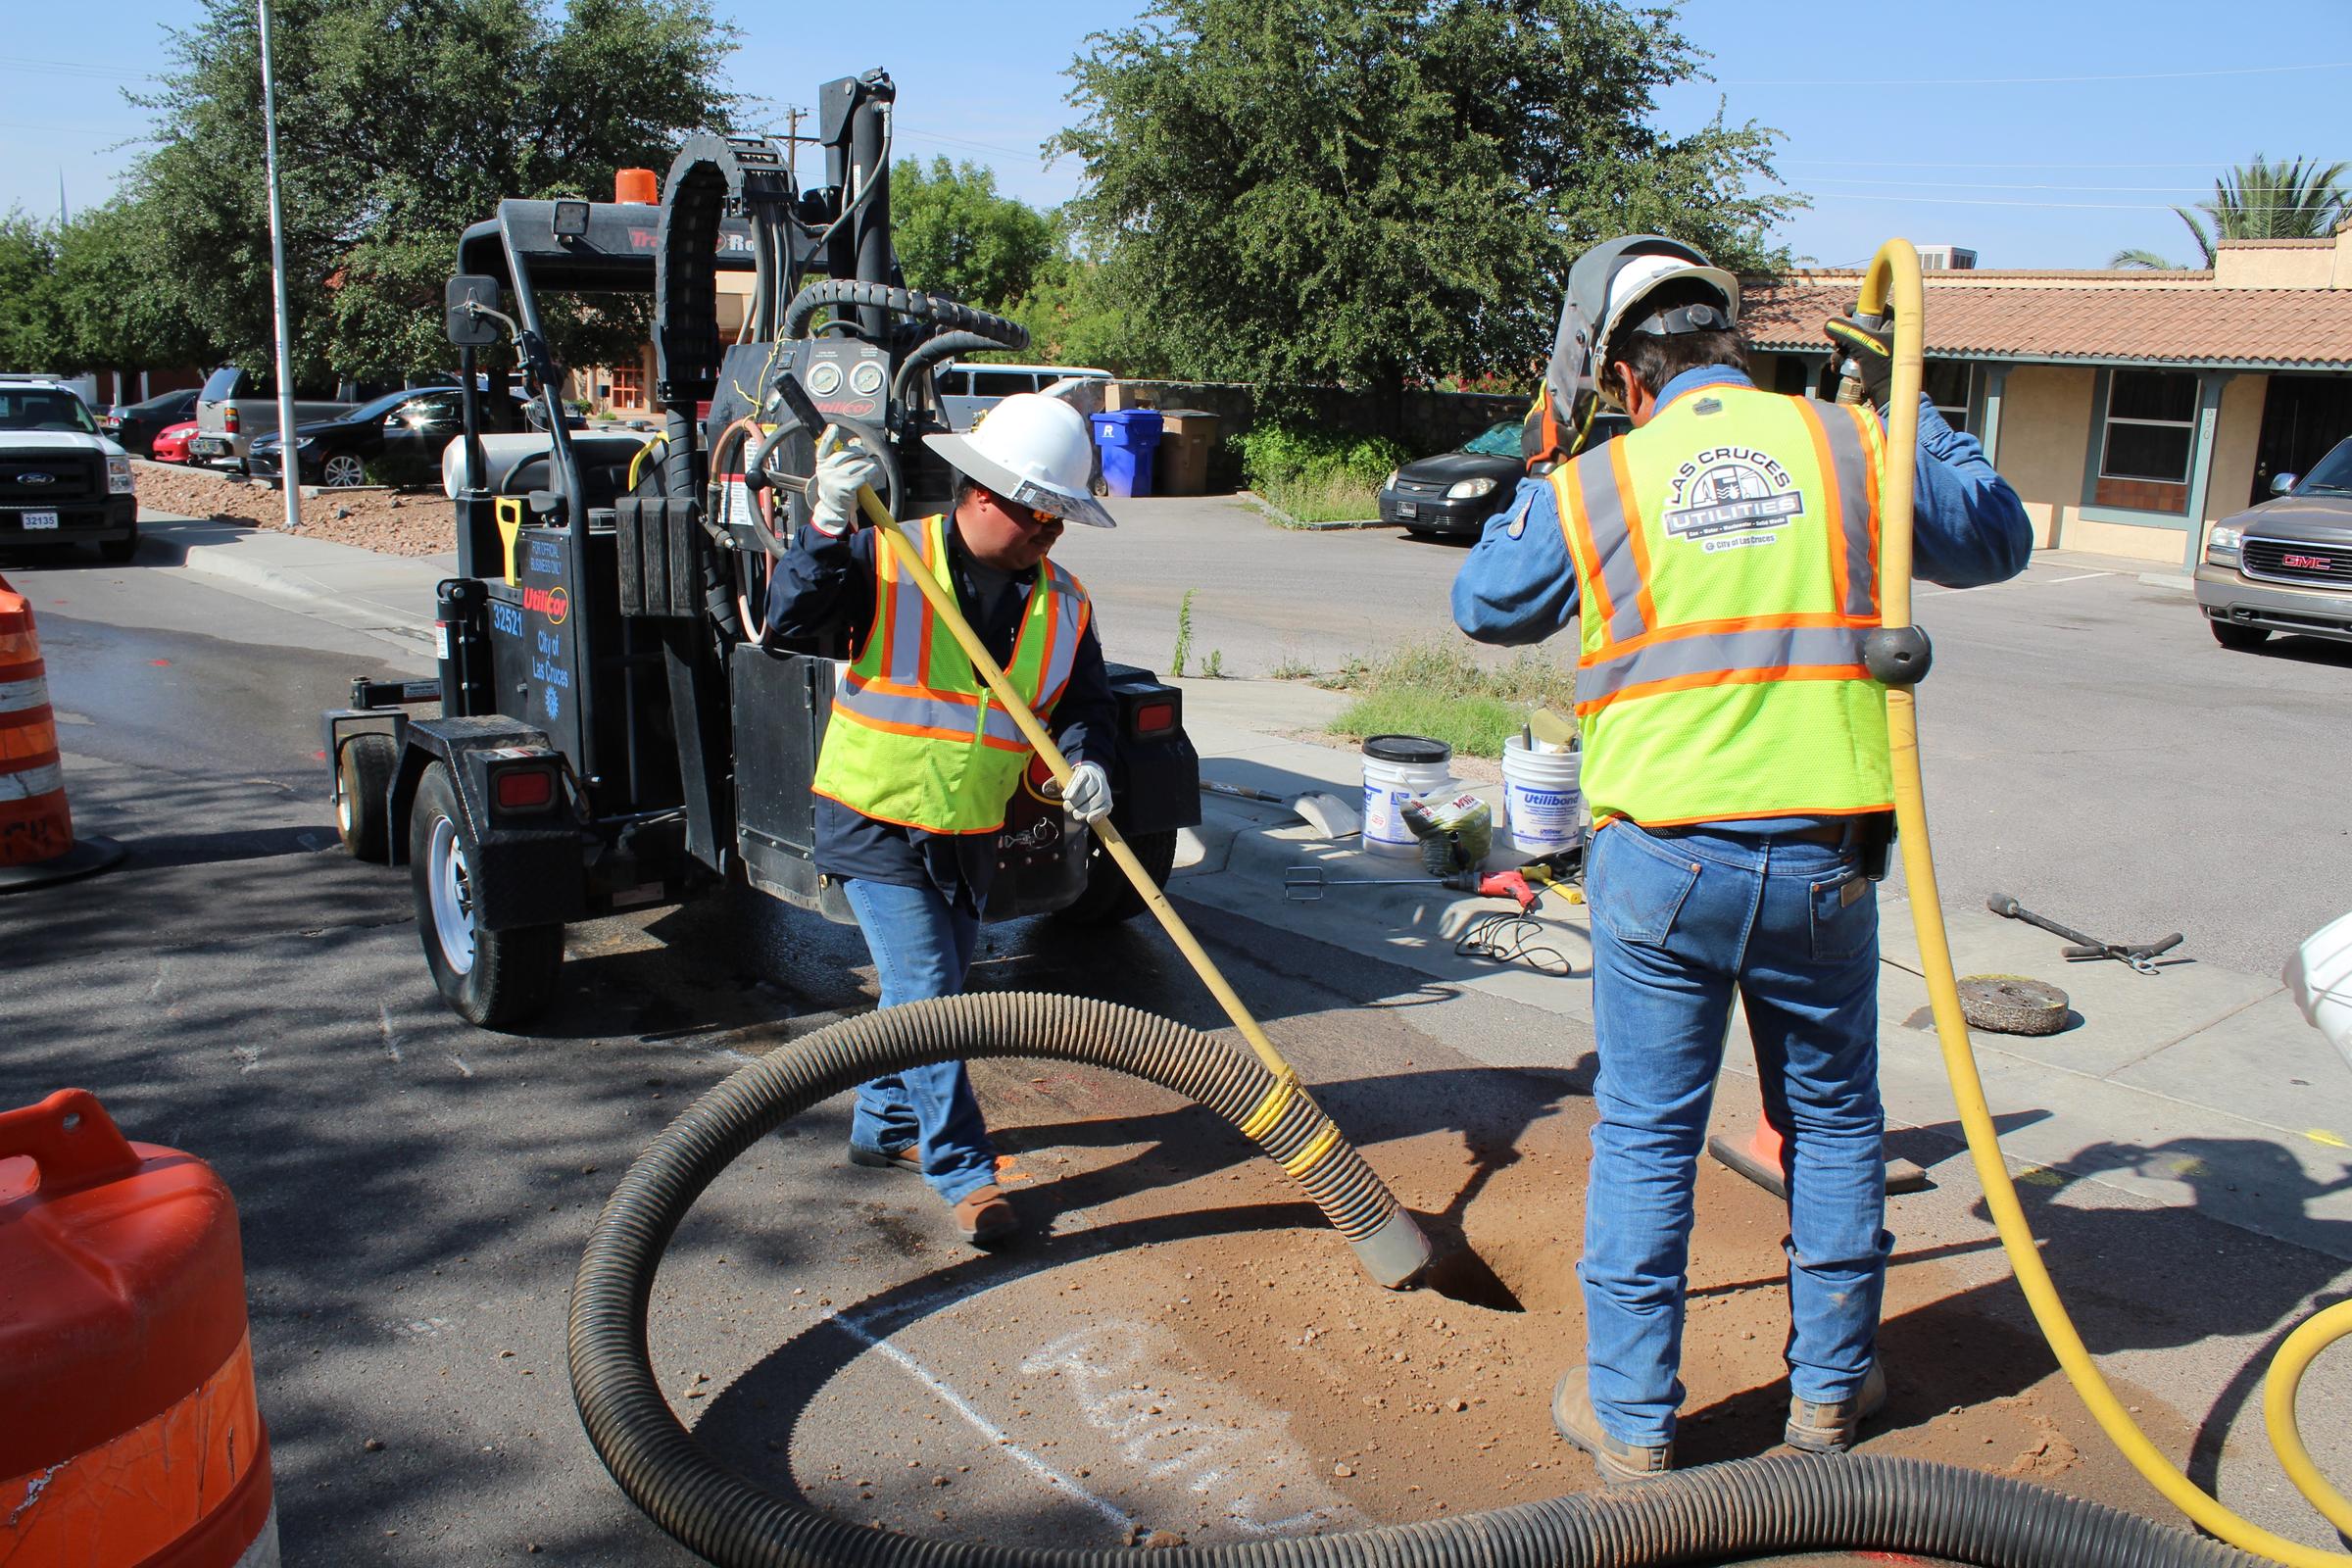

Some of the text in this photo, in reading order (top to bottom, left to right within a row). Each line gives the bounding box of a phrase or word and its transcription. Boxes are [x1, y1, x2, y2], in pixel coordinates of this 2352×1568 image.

[815, 400, 874, 415] tilicor
[1671, 448, 1790, 505] LAS CRUCES
[25, 516, 55, 525] 32135
[1672, 497, 1797, 529] UTILITIES
[1716, 540, 1731, 549] City
[2282, 554, 2331, 571] GMC
[523, 587, 566, 616] Utilicor
[493, 604, 522, 637] 32521
[538, 630, 560, 660] City of
[532, 656, 568, 689] Las Cruces
[1524, 793, 1579, 807] Utilibond
